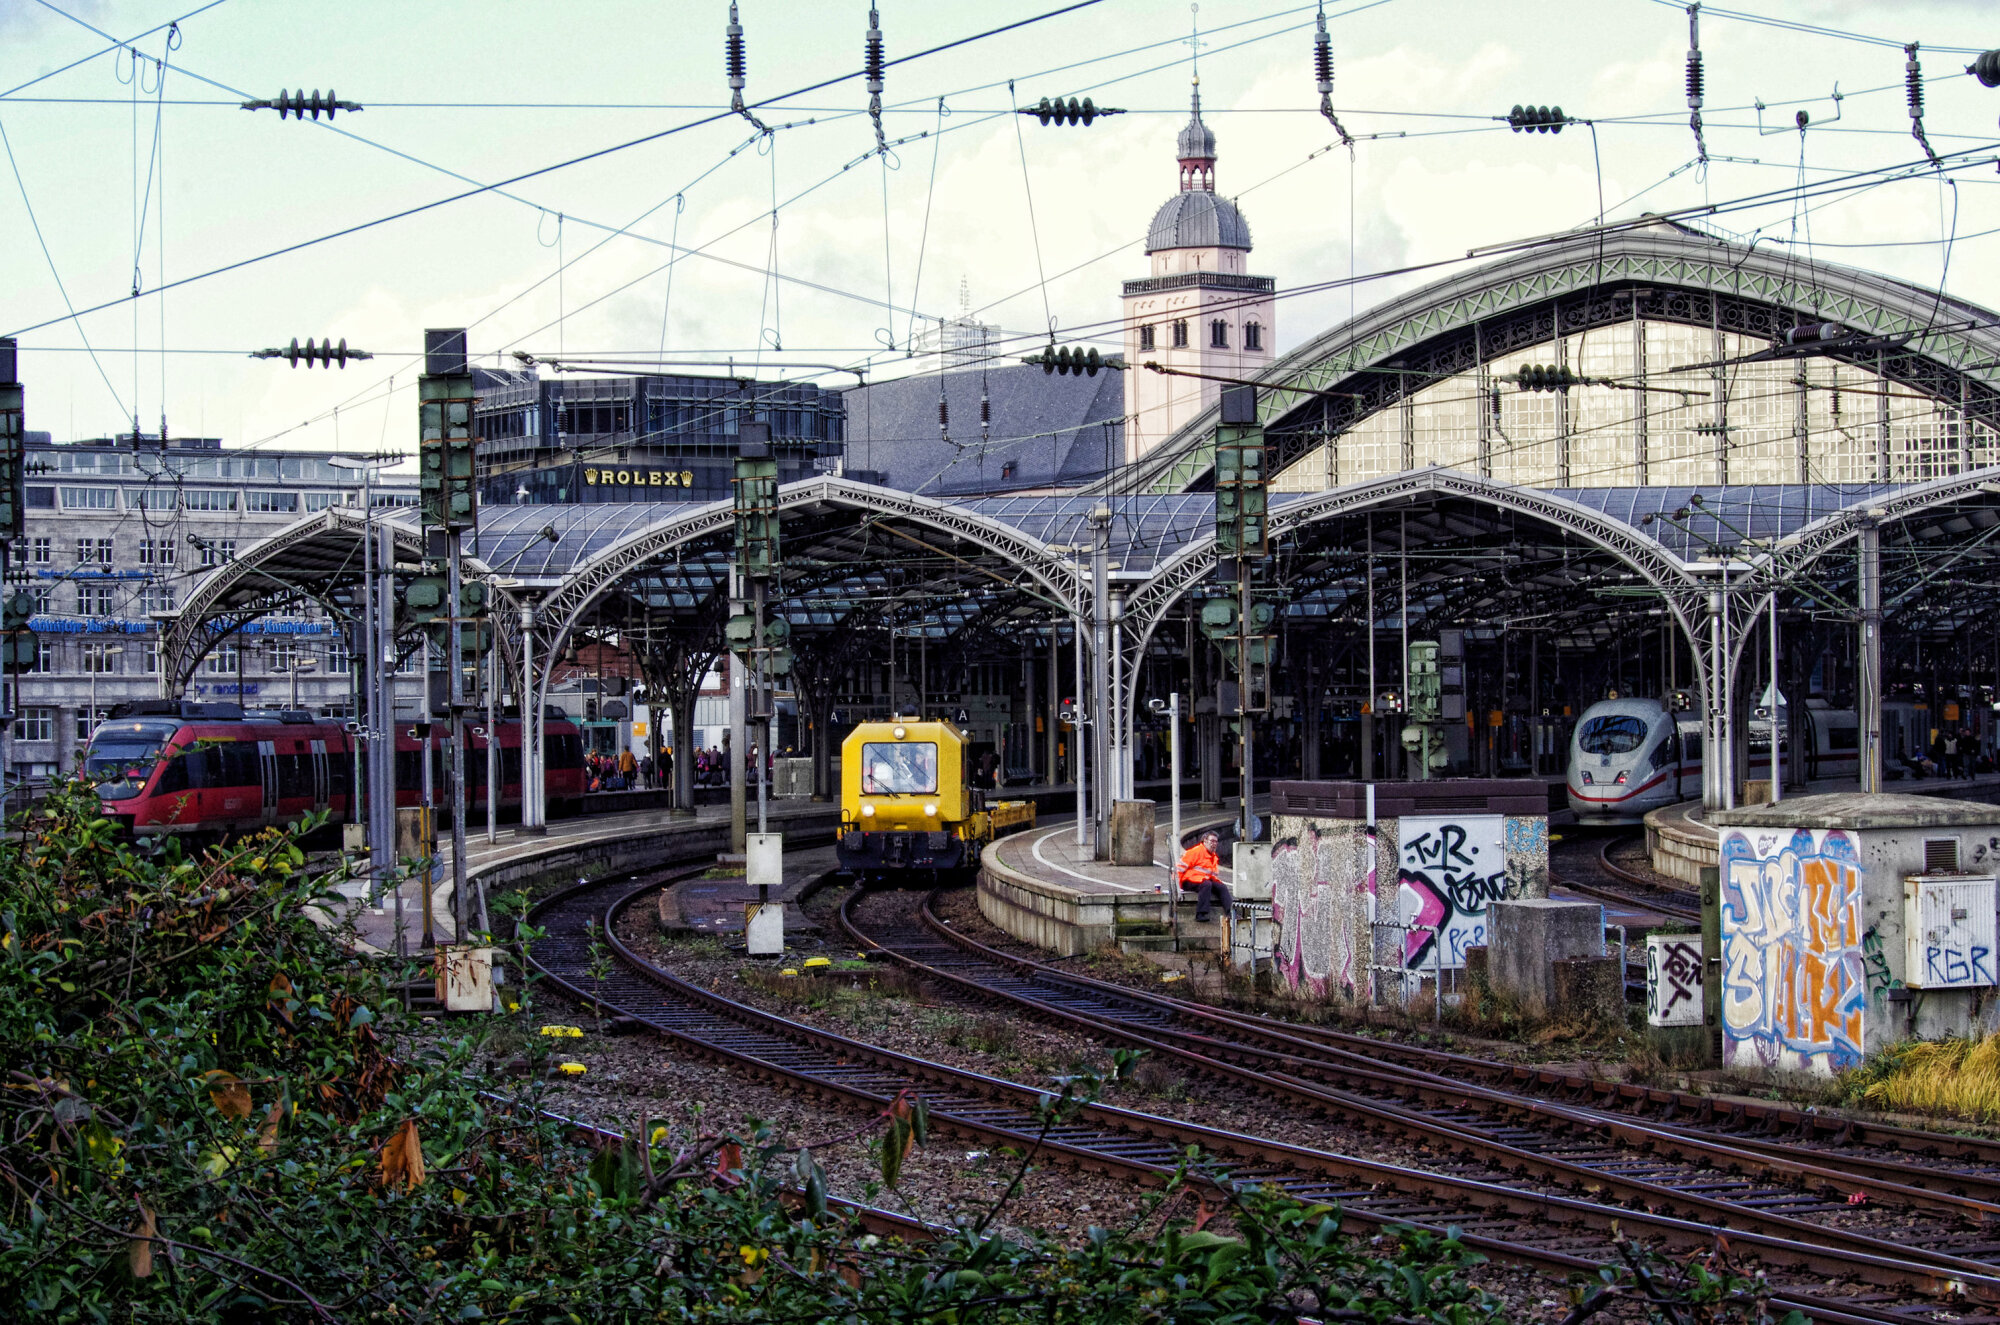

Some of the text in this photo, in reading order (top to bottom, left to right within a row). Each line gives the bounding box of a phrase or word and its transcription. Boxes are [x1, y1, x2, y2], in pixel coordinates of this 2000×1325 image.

[601, 470, 678, 486] ROLEX
[830, 712, 838, 723] A
[959, 710, 968, 721] A
[1926, 946, 1996, 985] RGR
